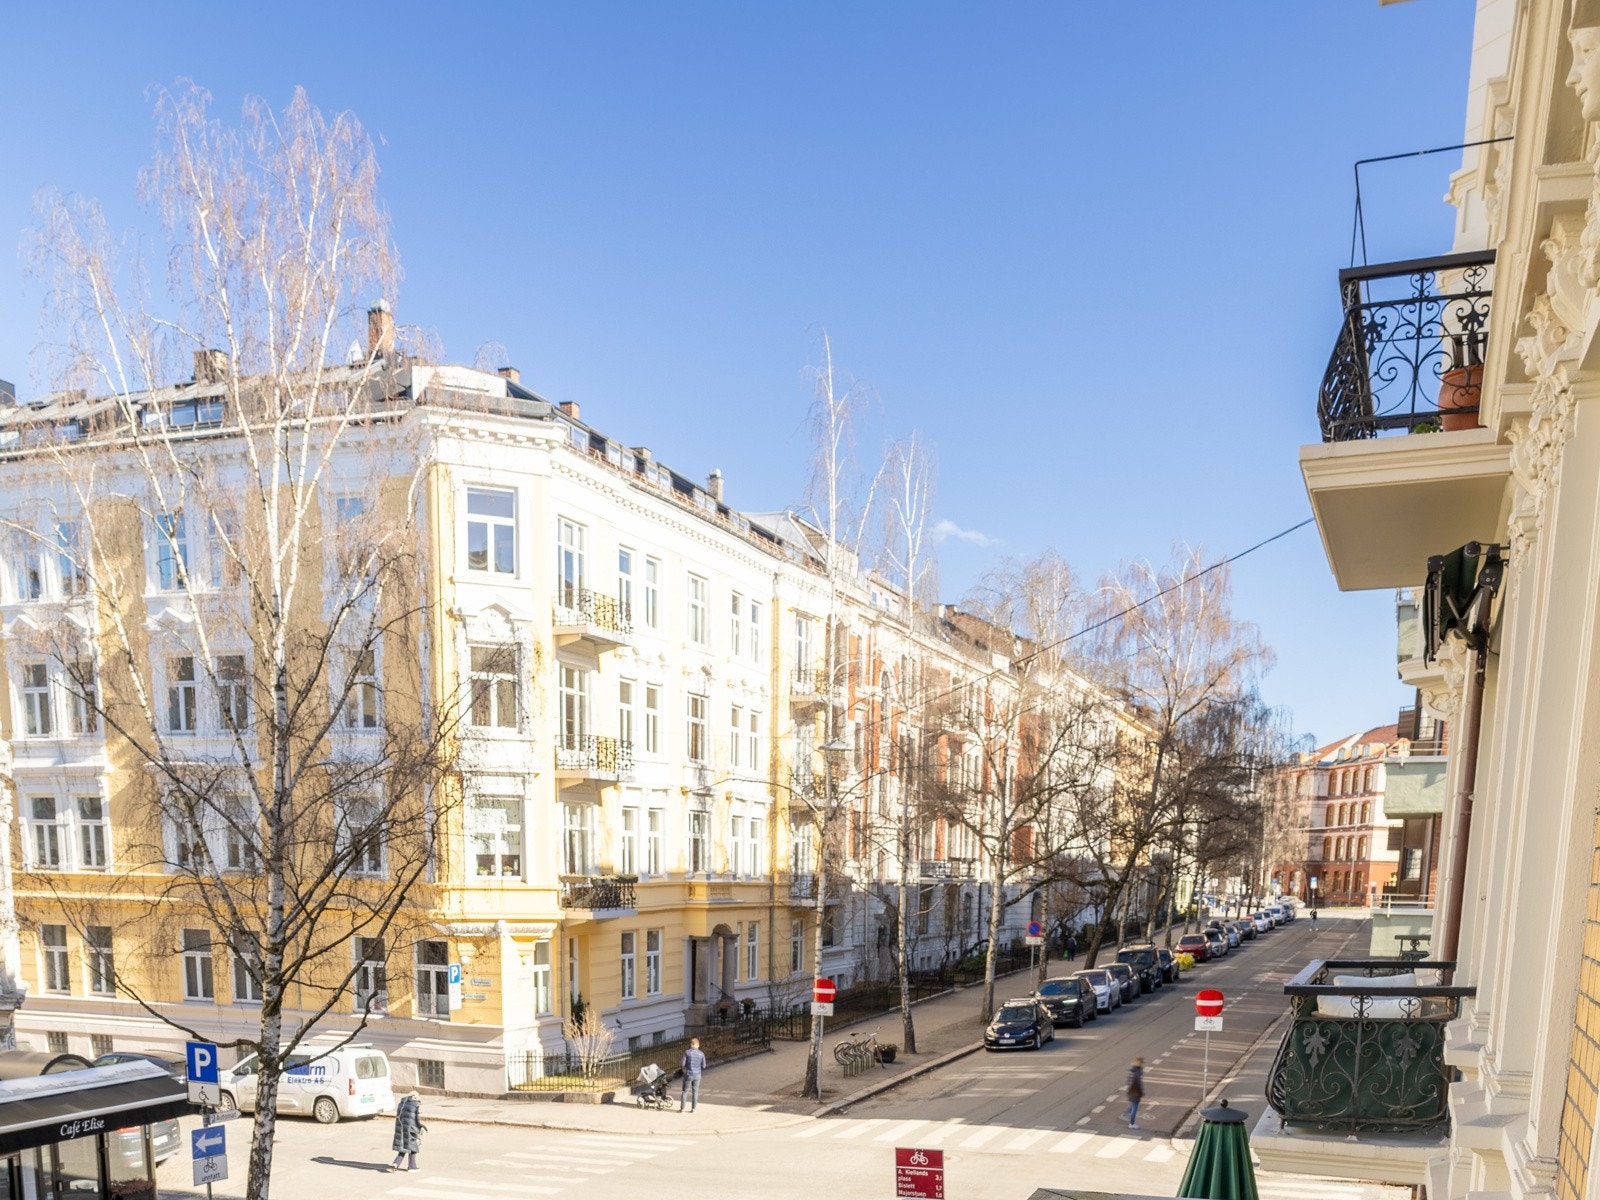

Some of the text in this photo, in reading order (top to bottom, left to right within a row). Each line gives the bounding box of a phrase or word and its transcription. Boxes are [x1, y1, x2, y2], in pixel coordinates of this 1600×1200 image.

[451, 966, 458, 982] P
[194, 1047, 211, 1078] P
[287, 1076, 312, 1084] Elektro
[60, 1117, 105, 1138] Café Elise
